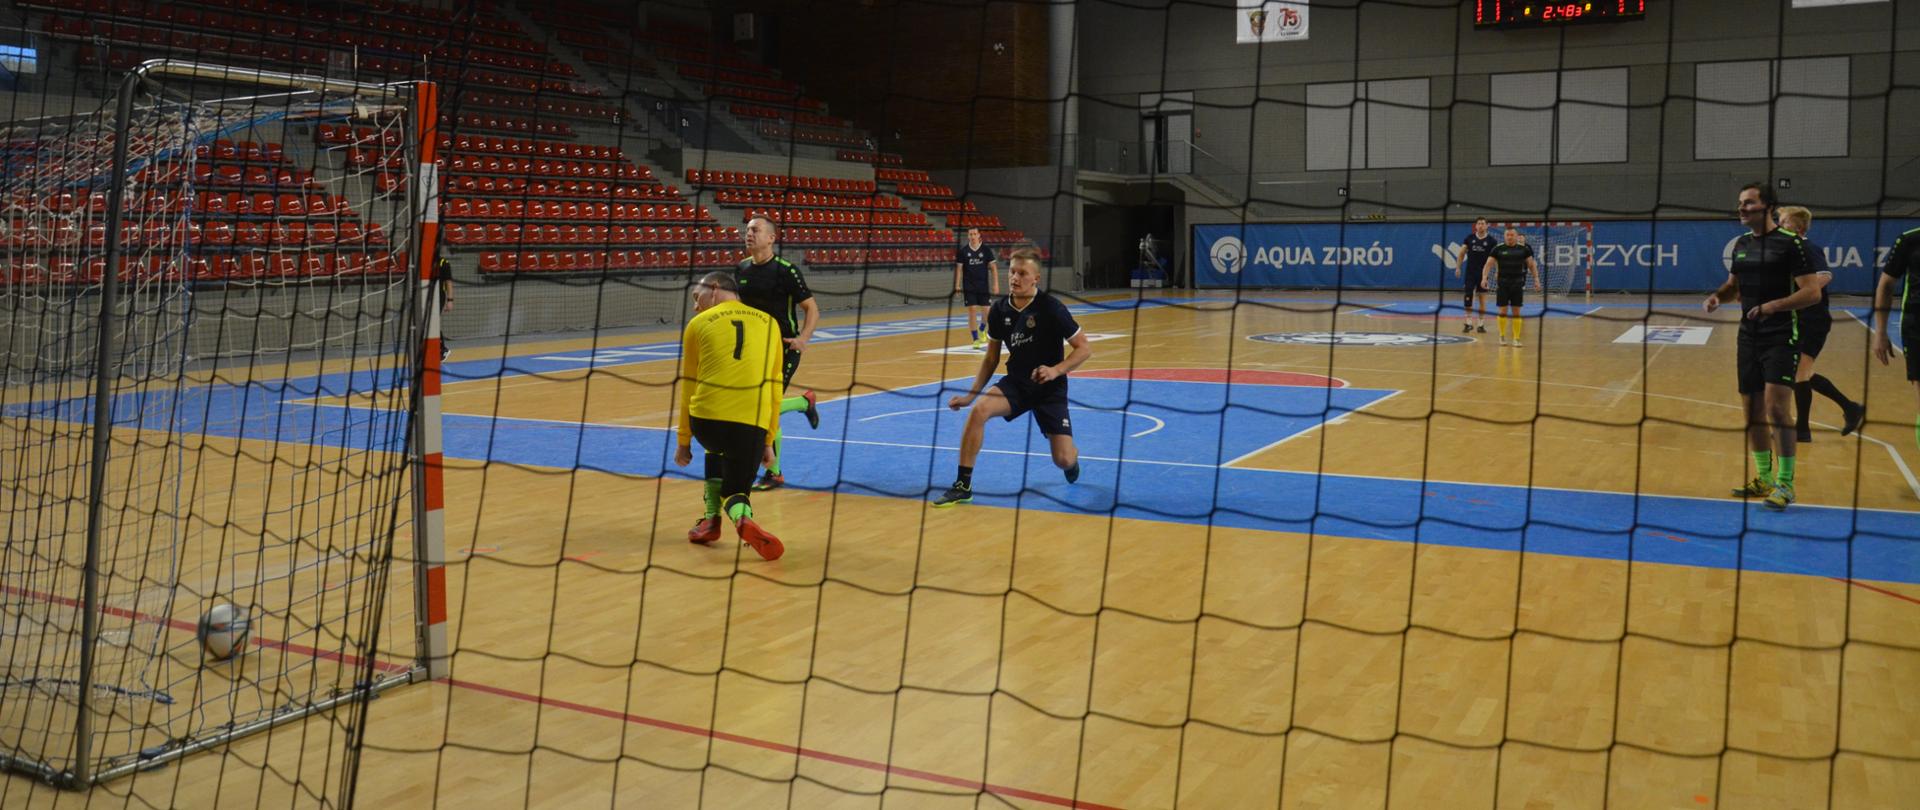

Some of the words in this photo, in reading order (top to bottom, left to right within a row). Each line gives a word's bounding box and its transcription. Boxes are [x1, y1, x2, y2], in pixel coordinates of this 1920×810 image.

[1253, 247, 1316, 269] AQUA
[1322, 241, 1394, 266] ZDRÓJ
[1537, 243, 1678, 267] ŁBRZYCH
[1823, 246, 1864, 268] UA
[731, 319, 744, 361] 1
